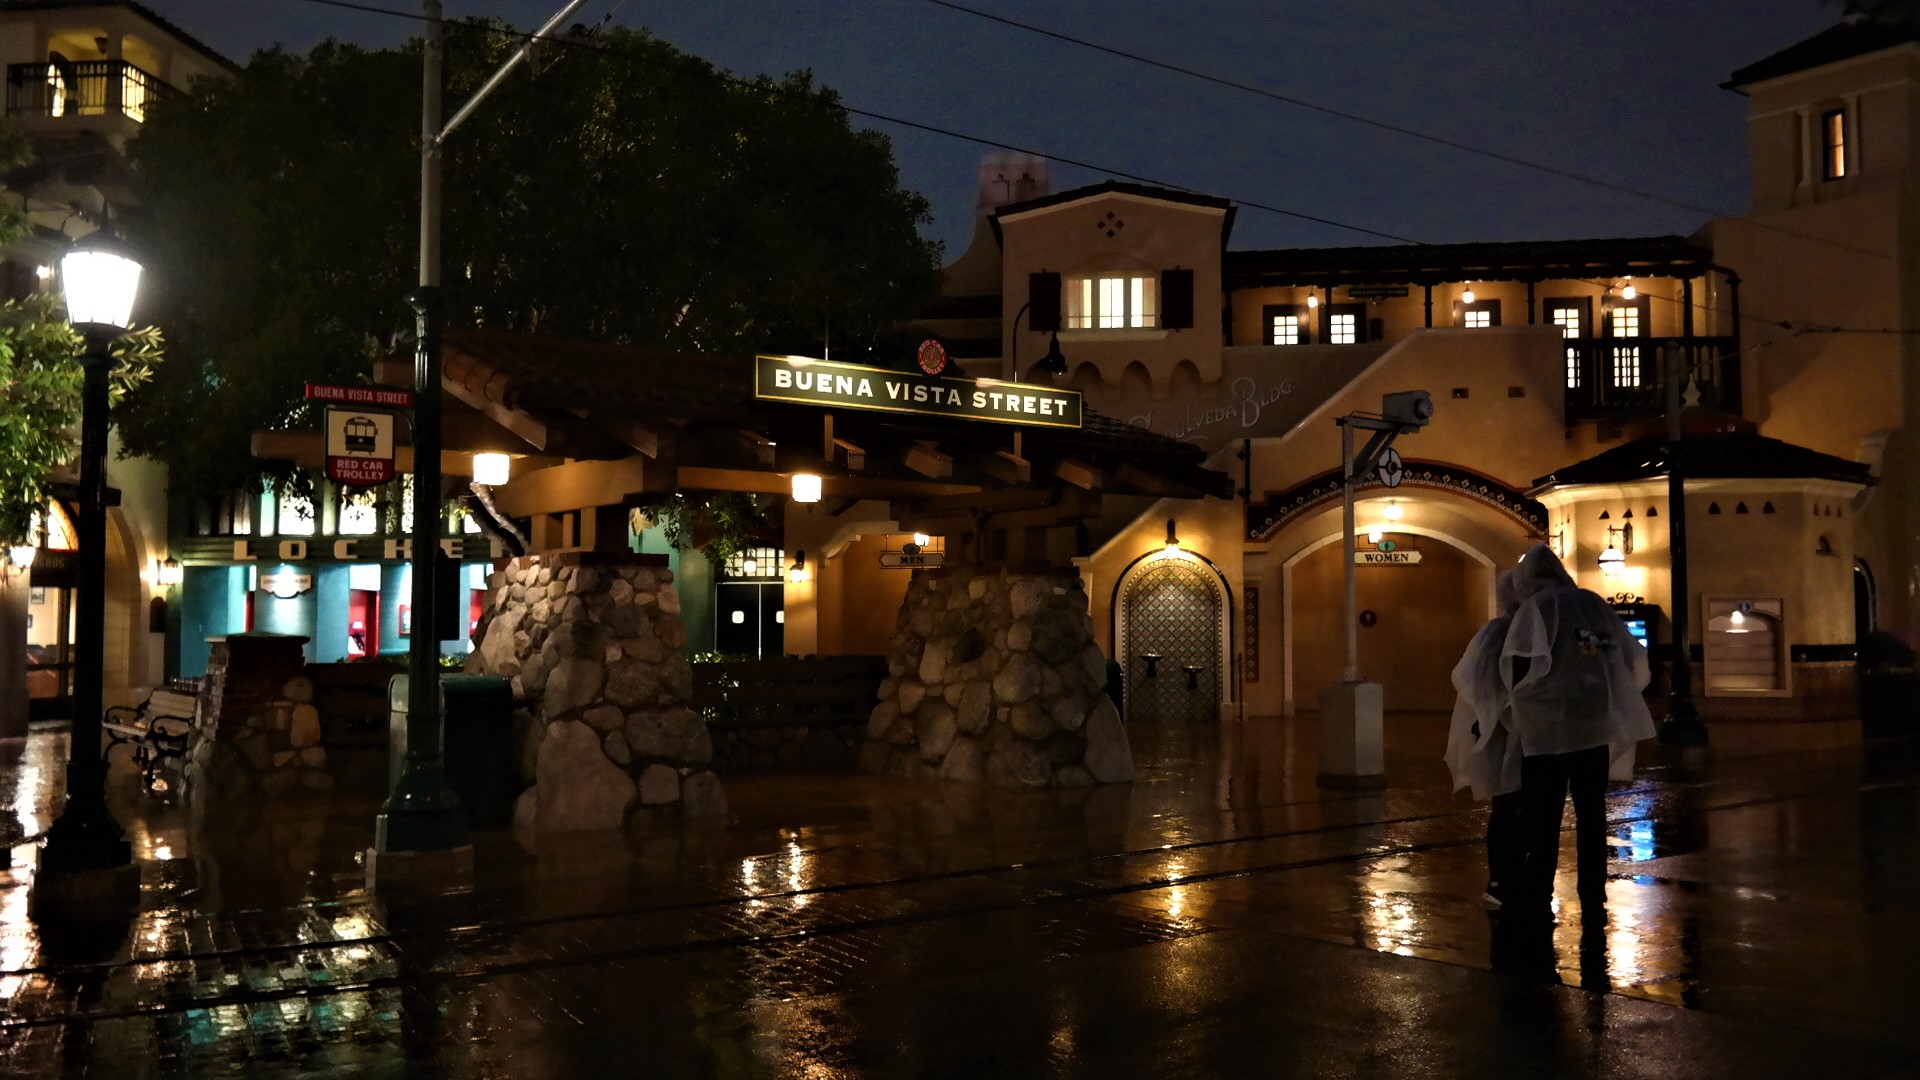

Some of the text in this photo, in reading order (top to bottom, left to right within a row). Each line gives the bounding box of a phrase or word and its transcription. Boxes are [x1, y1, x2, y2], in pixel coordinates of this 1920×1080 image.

[314, 386, 408, 405] BUENA VISTA STREET
[774, 368, 1068, 417] BUENA VISTA STREET
[336, 459, 384, 470] RED CAR
[335, 469, 385, 481] TROLLEY
[899, 556, 924, 564] MEN
[1364, 553, 1409, 563] WOMEN
